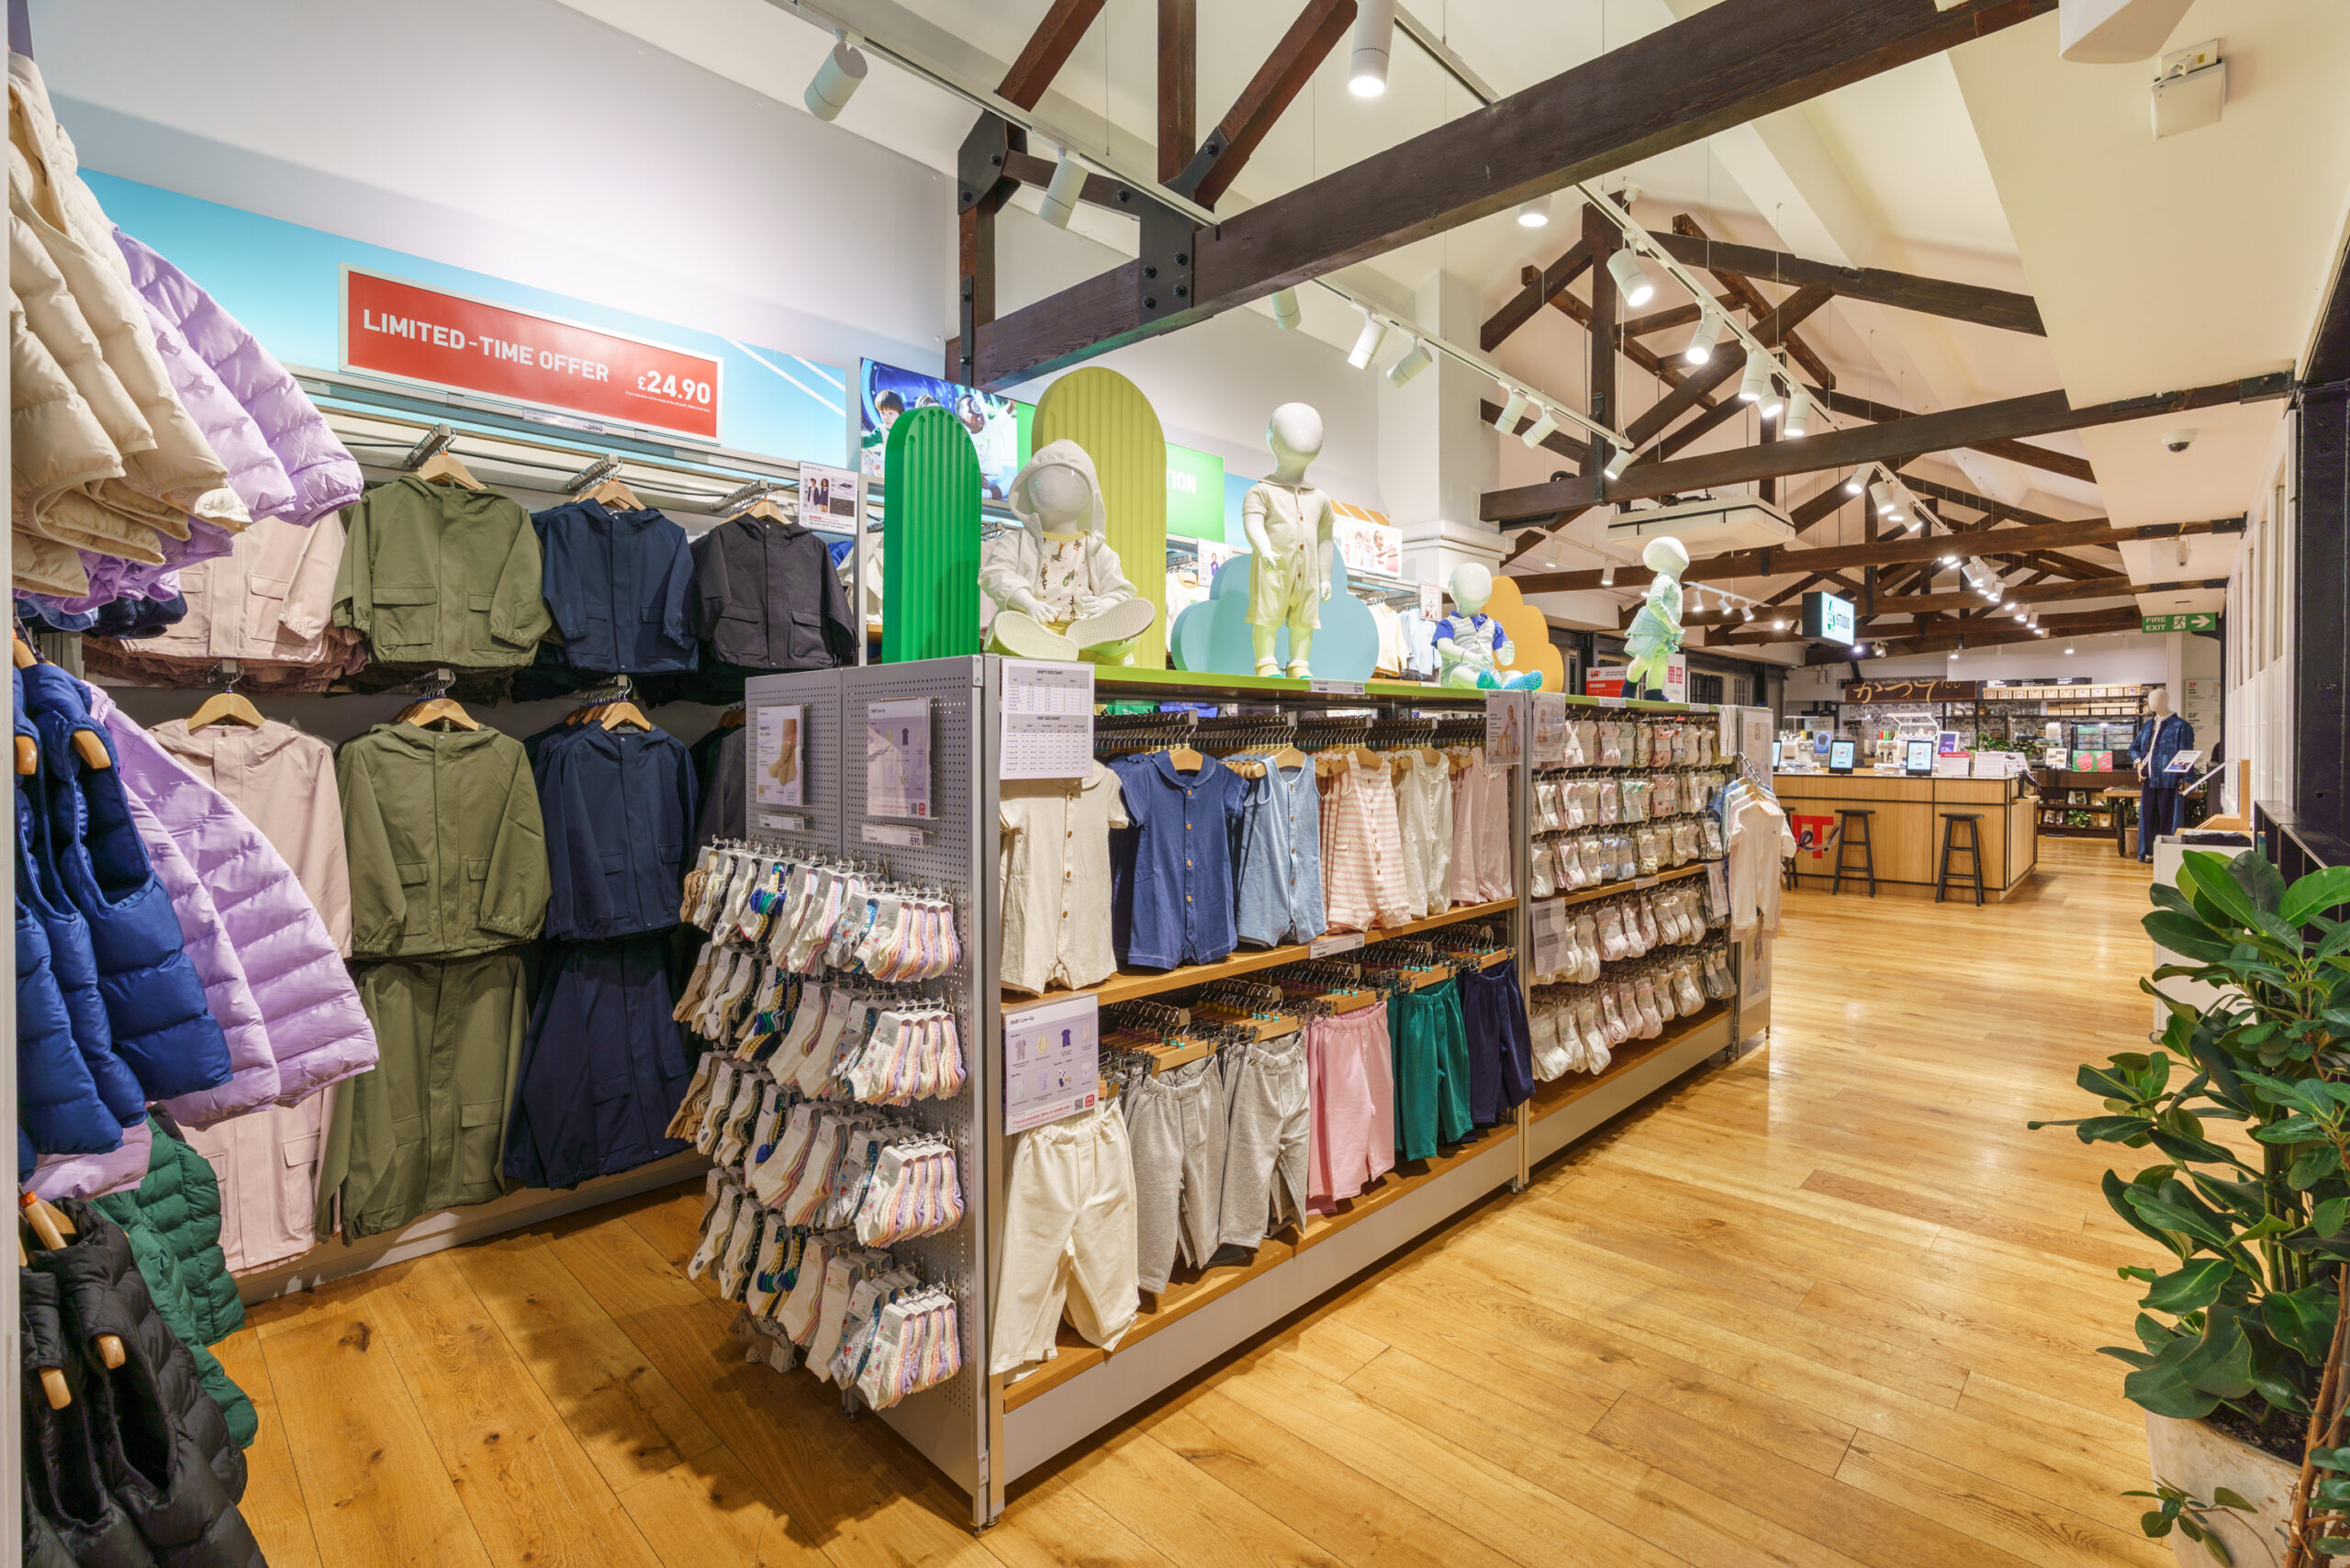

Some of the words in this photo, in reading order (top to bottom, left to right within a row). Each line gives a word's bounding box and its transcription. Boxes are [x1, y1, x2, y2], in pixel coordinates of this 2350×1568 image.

[364, 308, 533, 366] LIMITED-TIME
[539, 350, 610, 382] OFFER
[637, 370, 711, 405] £24.90
